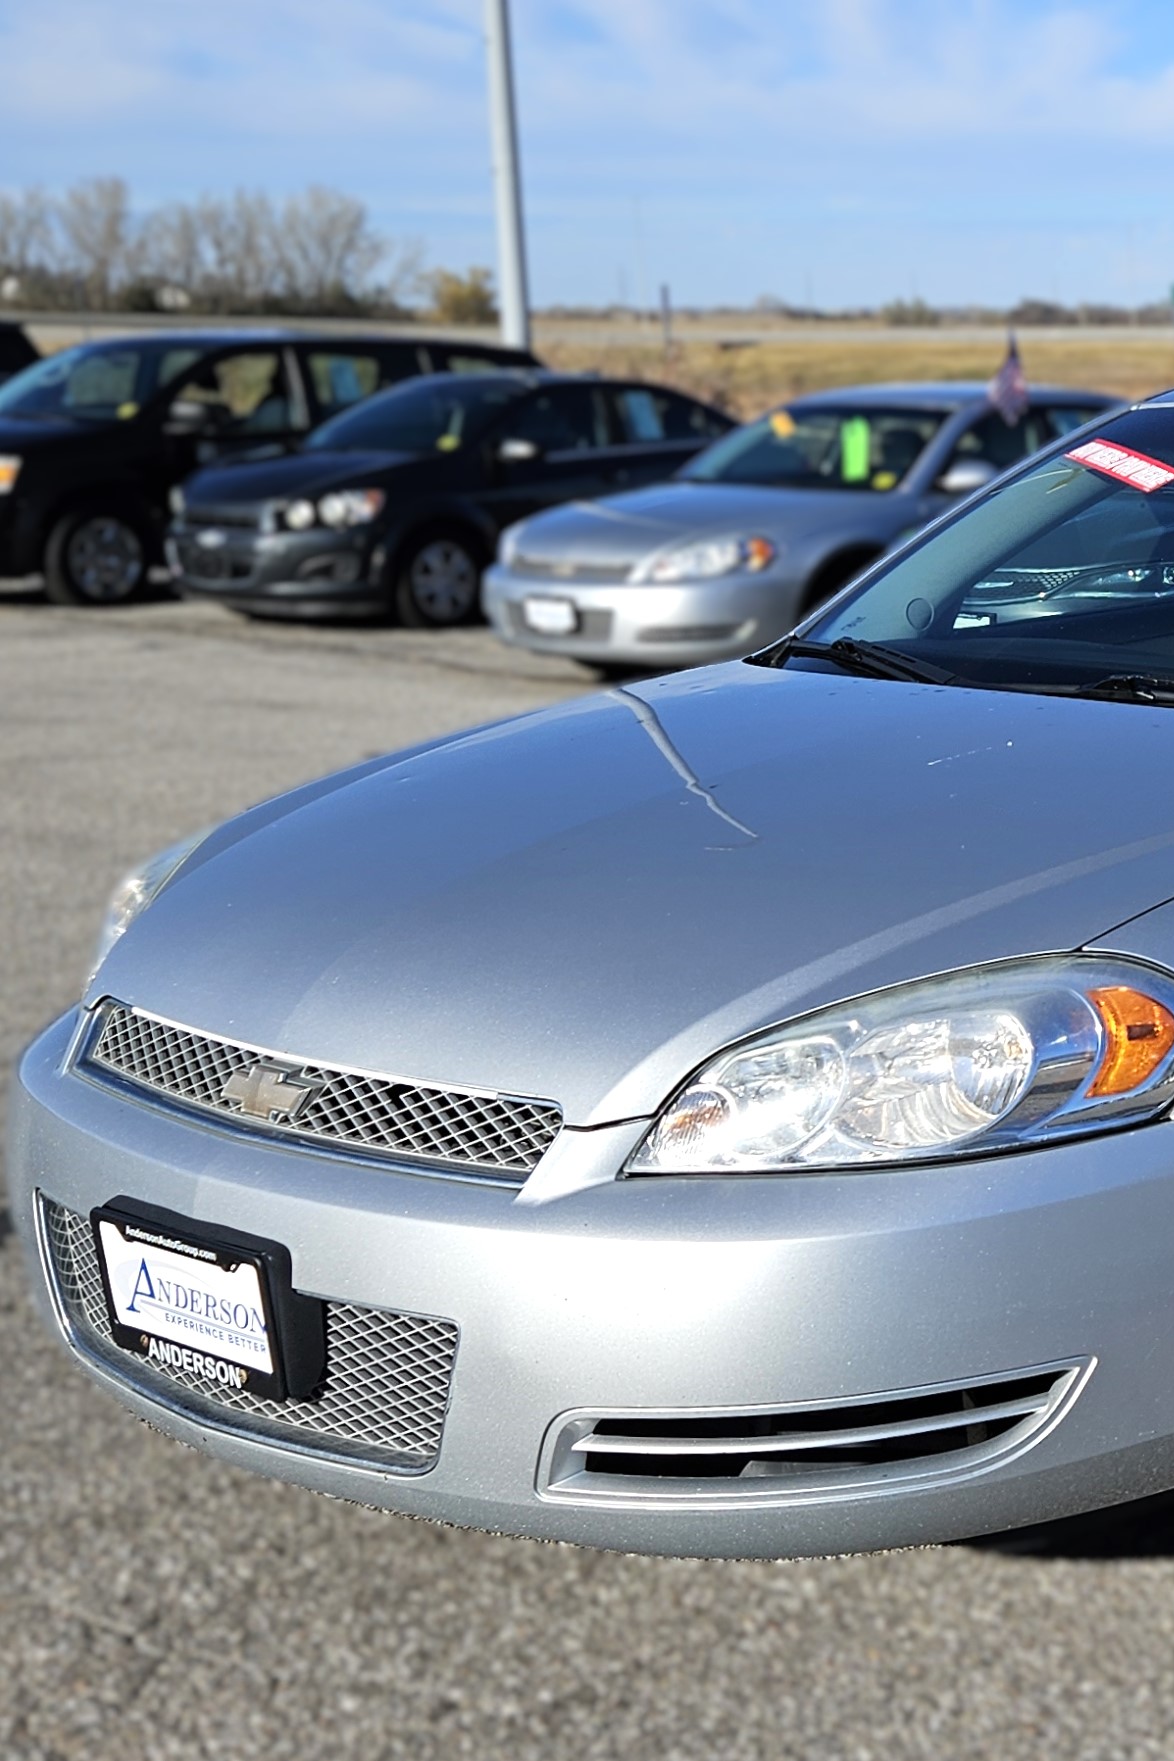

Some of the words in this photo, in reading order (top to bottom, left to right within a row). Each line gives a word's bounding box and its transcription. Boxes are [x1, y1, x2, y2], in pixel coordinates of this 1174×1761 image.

[165, 1313, 224, 1341] EXPERIENCE
[227, 1333, 267, 1354] BETTER
[147, 1337, 243, 1389] ANDERSON
